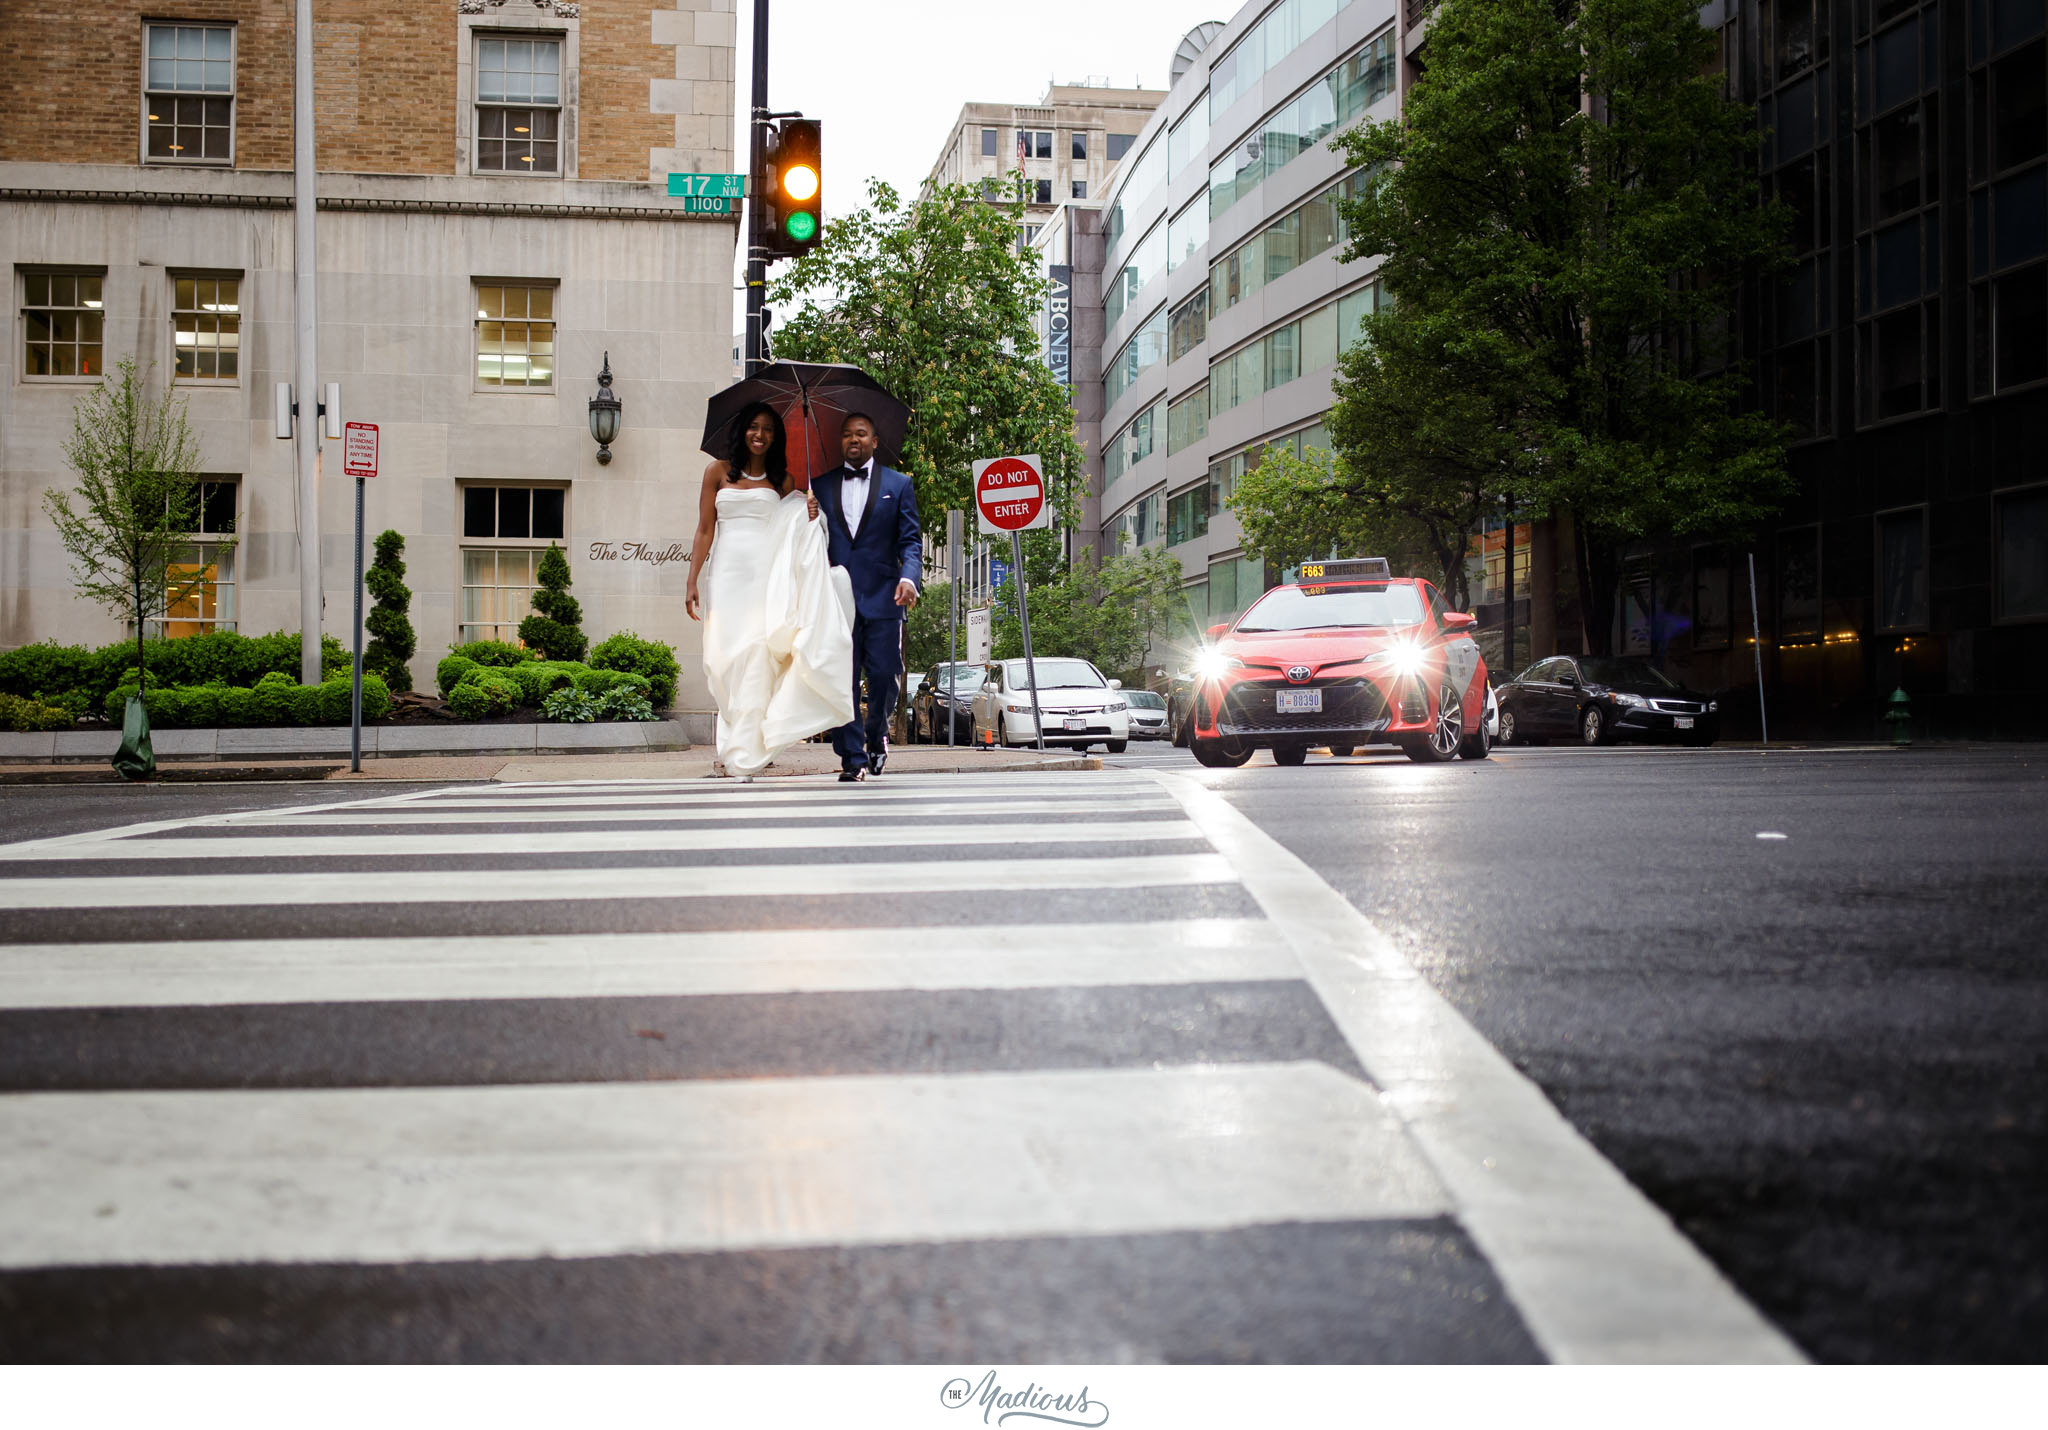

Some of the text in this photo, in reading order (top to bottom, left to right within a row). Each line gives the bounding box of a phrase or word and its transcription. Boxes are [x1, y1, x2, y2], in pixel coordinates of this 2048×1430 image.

[682, 175, 738, 195] 17 ST
[722, 186, 739, 197] NW
[692, 197, 723, 211] 1100
[349, 437, 375, 445] STANDING
[987, 470, 1029, 485] DO NOT
[994, 503, 1030, 518] ENTER
[589, 542, 618, 561] The
[1302, 565, 1323, 578] F663
